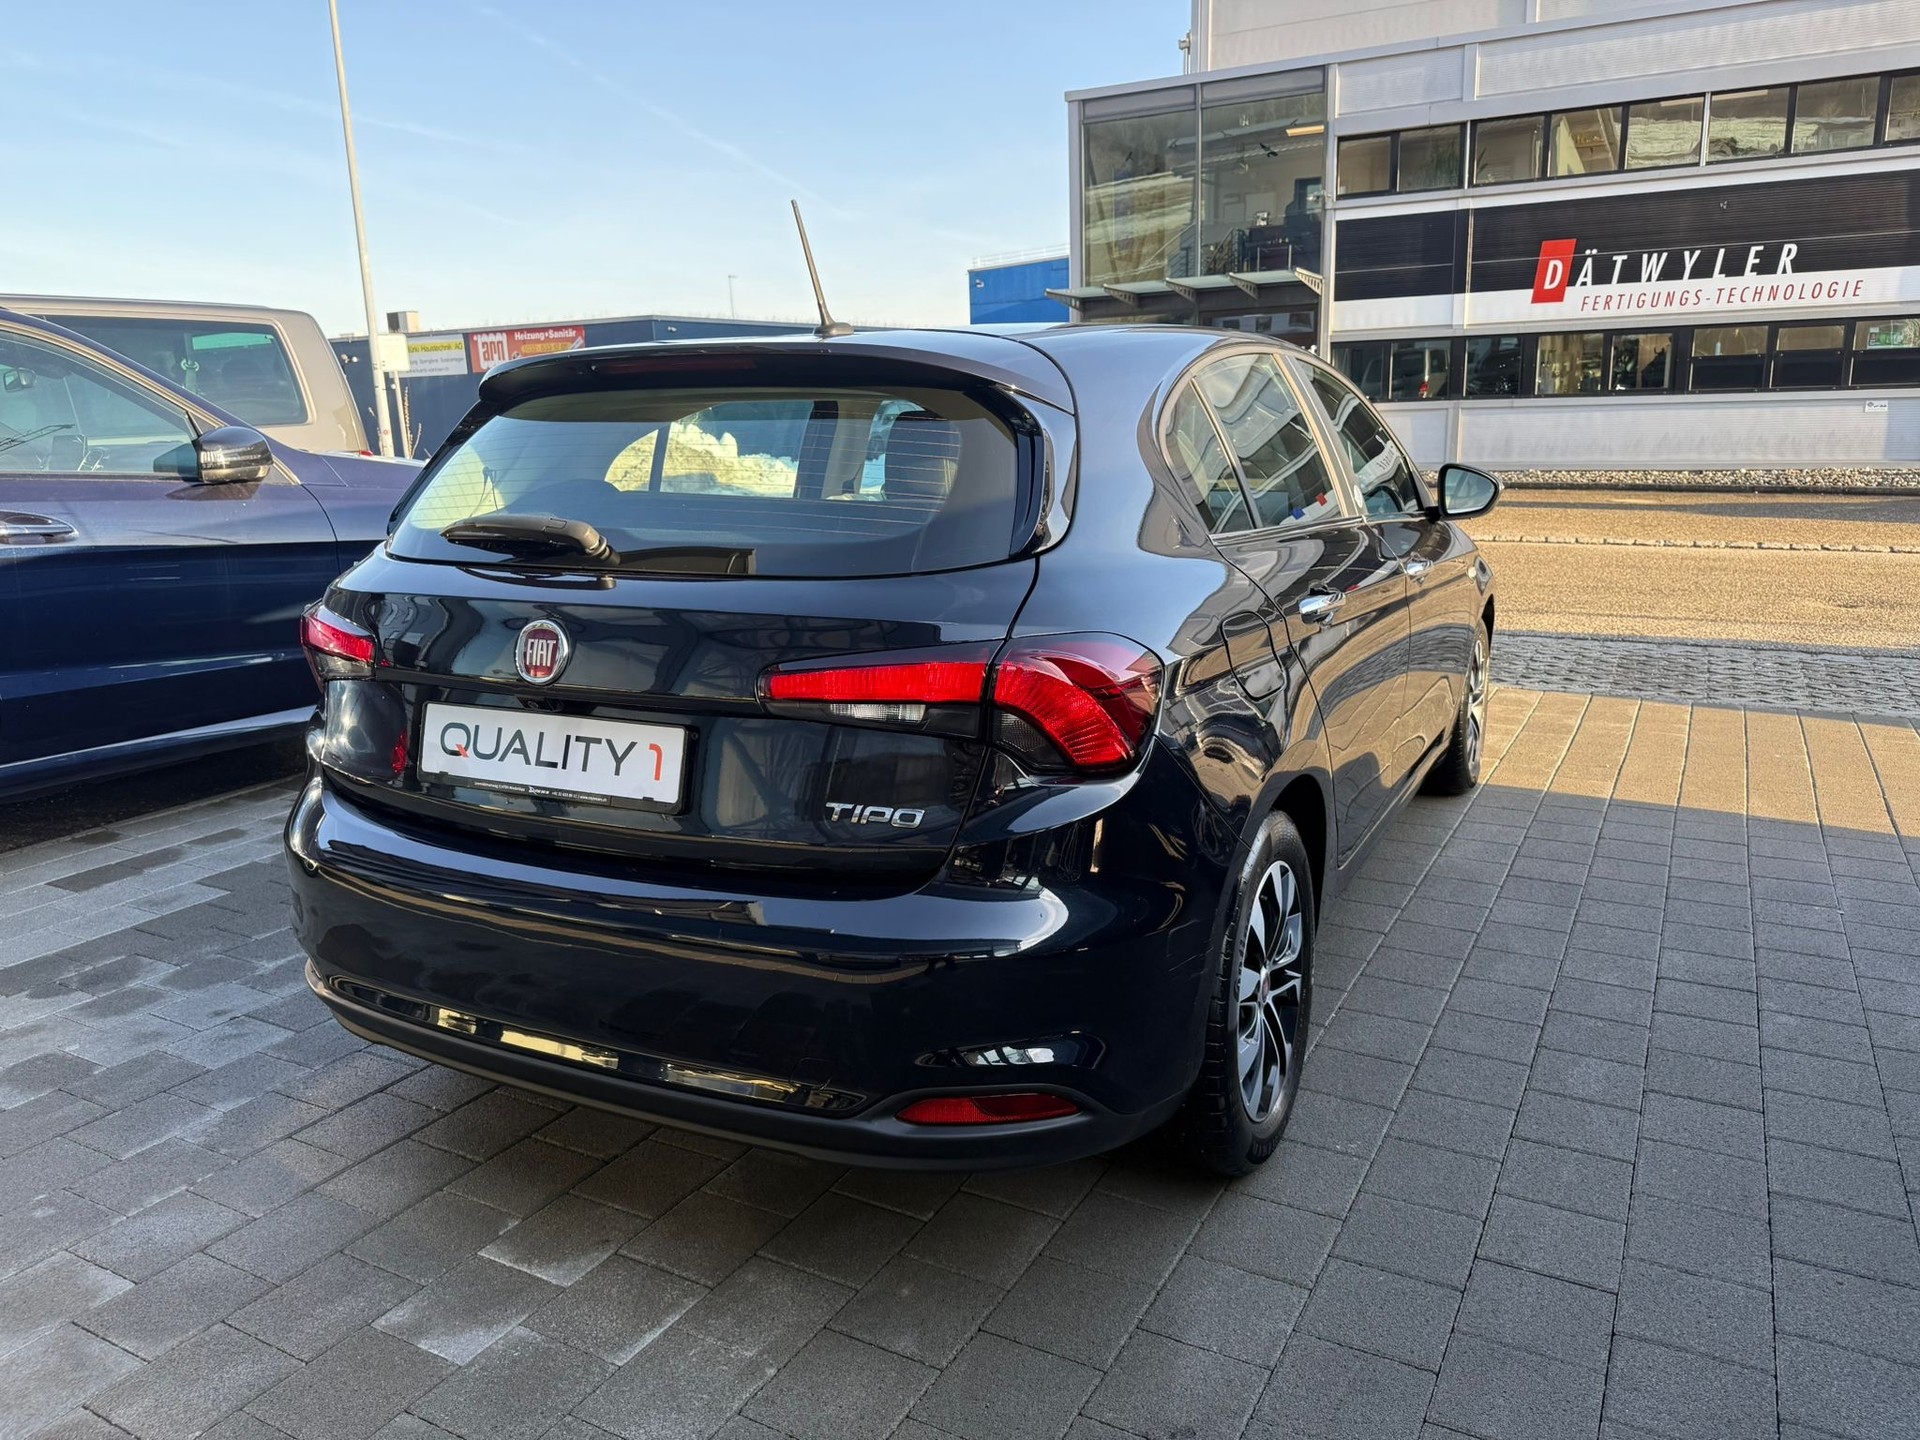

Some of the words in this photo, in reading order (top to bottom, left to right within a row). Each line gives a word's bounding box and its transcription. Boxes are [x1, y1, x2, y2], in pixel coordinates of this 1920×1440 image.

[1544, 243, 1798, 290] DÄTWYLER
[1580, 280, 1864, 312] FERTIGUNGS-TECHNOLOGIE
[526, 638, 556, 667] FIAT
[440, 722, 638, 776] QUALITY
[825, 802, 926, 829] TIPO
